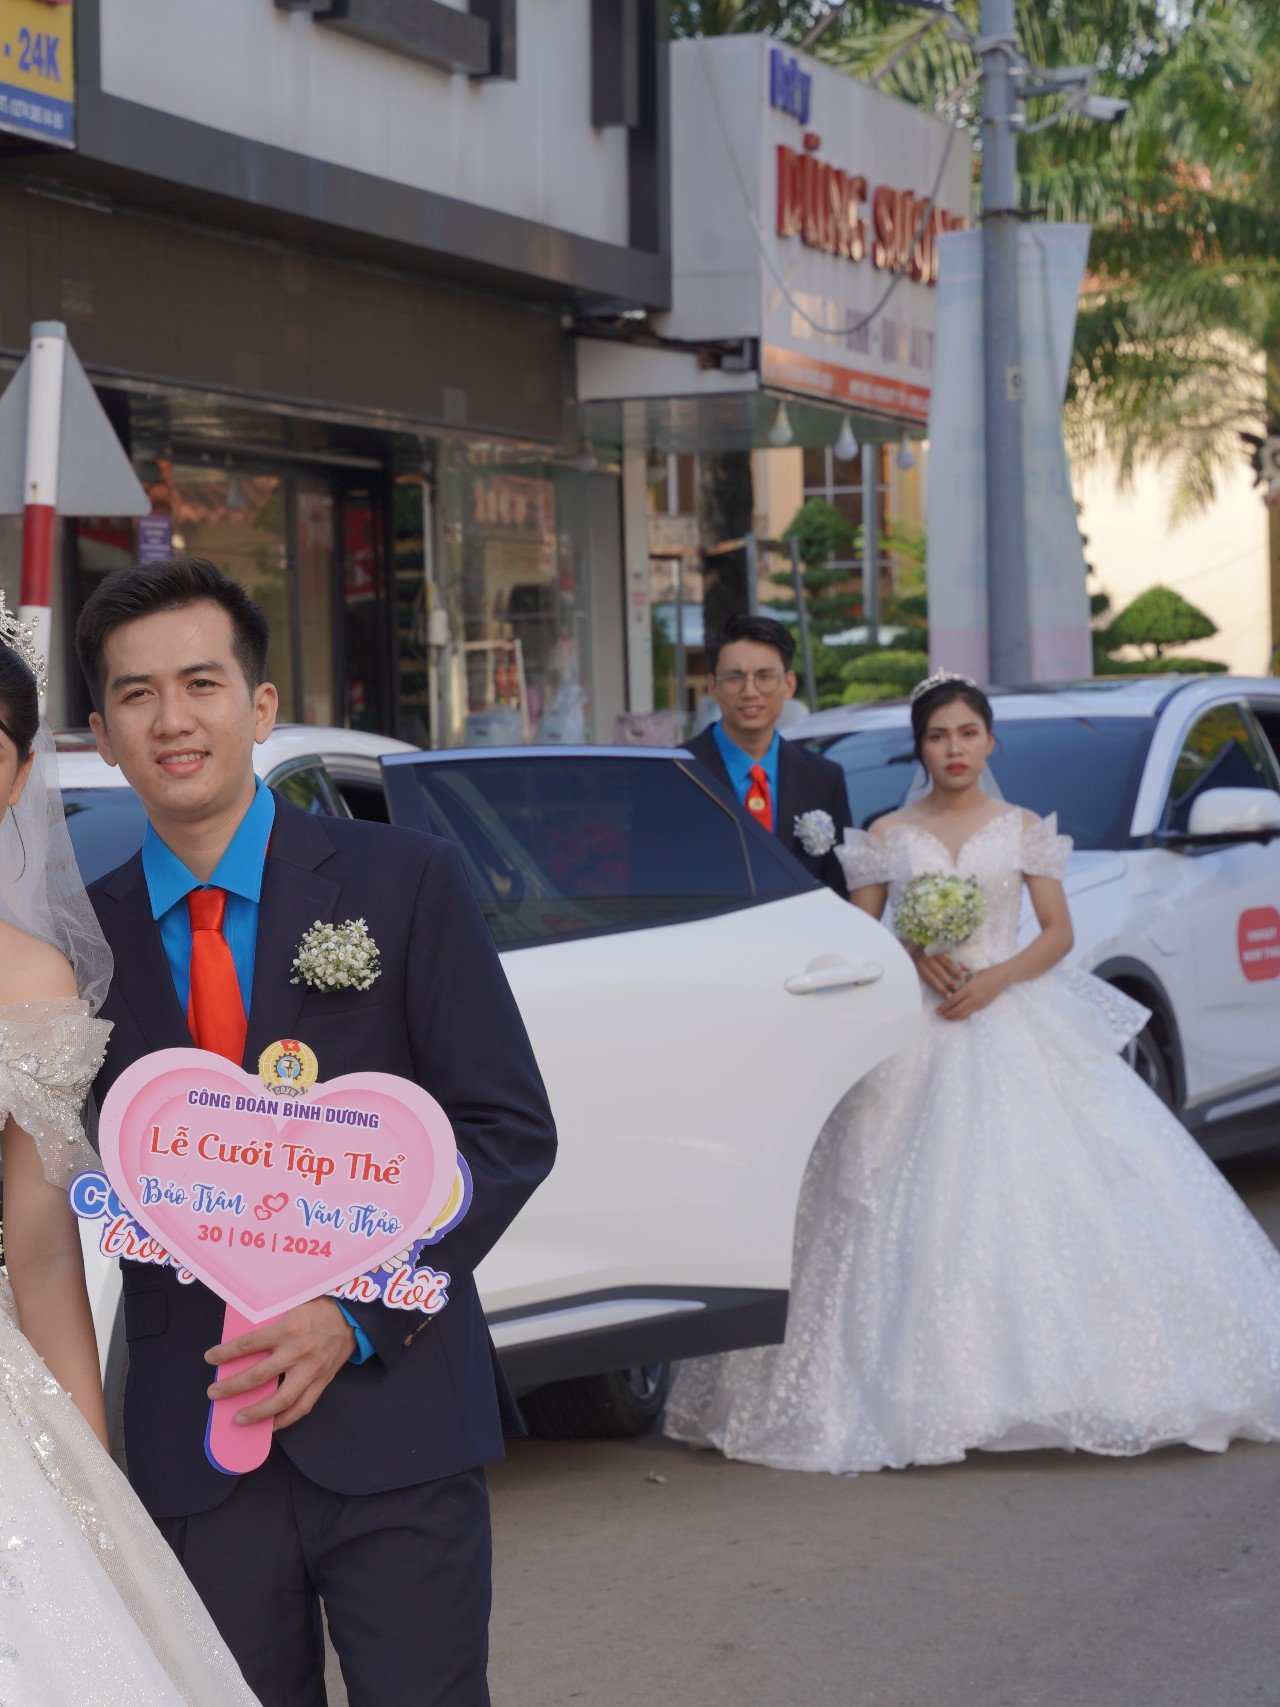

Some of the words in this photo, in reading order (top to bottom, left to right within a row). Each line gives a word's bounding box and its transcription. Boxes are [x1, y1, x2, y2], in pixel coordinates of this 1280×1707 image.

[18, 27, 62, 83] 24K
[188, 1088, 231, 1109] CÔNG
[235, 1095, 279, 1116] ĐOÀN
[283, 1099, 321, 1121] BÌNH
[325, 1108, 379, 1129] DƯƠNG
[150, 1125, 191, 1157] Lễ
[197, 1133, 274, 1168] Cưới
[281, 1143, 335, 1186] Tập
[343, 1151, 406, 1185] Thể
[139, 1176, 188, 1205] Bảo
[192, 1183, 245, 1214] Trân
[296, 1198, 344, 1229] Văn
[349, 1204, 401, 1237] Thảo
[104, 1217, 193, 1280] tro
[197, 1224, 223, 1243] 30
[240, 1230, 266, 1249] 06
[283, 1236, 332, 1257] 2024
[387, 1268, 441, 1309] tôi
